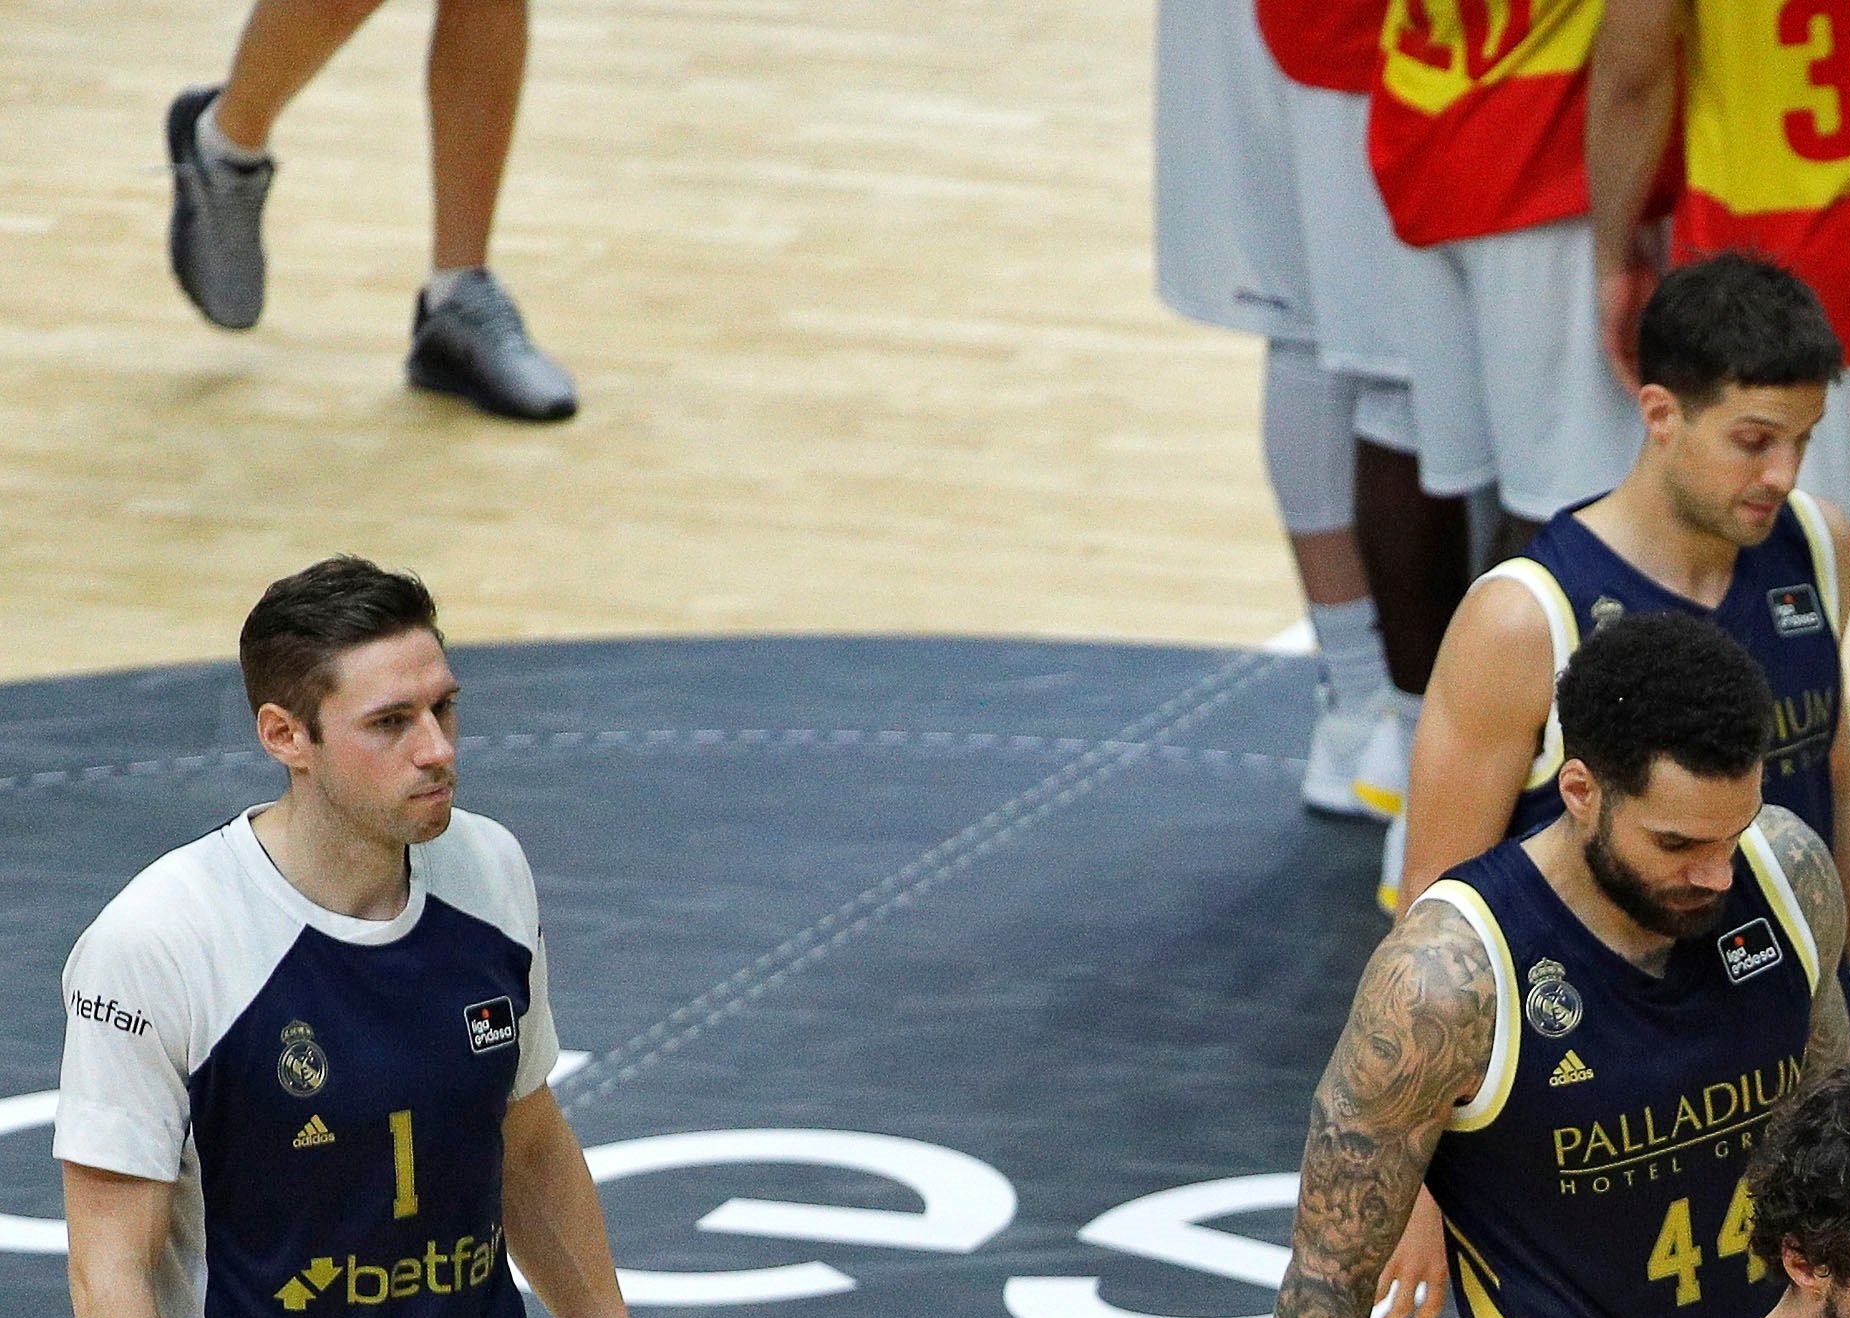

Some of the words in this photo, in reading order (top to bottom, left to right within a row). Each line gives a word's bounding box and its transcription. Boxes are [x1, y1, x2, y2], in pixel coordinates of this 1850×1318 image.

[1549, 1068, 1595, 1087] adidas
[292, 1132, 336, 1148] adidas
[389, 1109, 419, 1219] 1
[1560, 1158, 1682, 1195] HOTEL
[1647, 1177, 1767, 1307] 44
